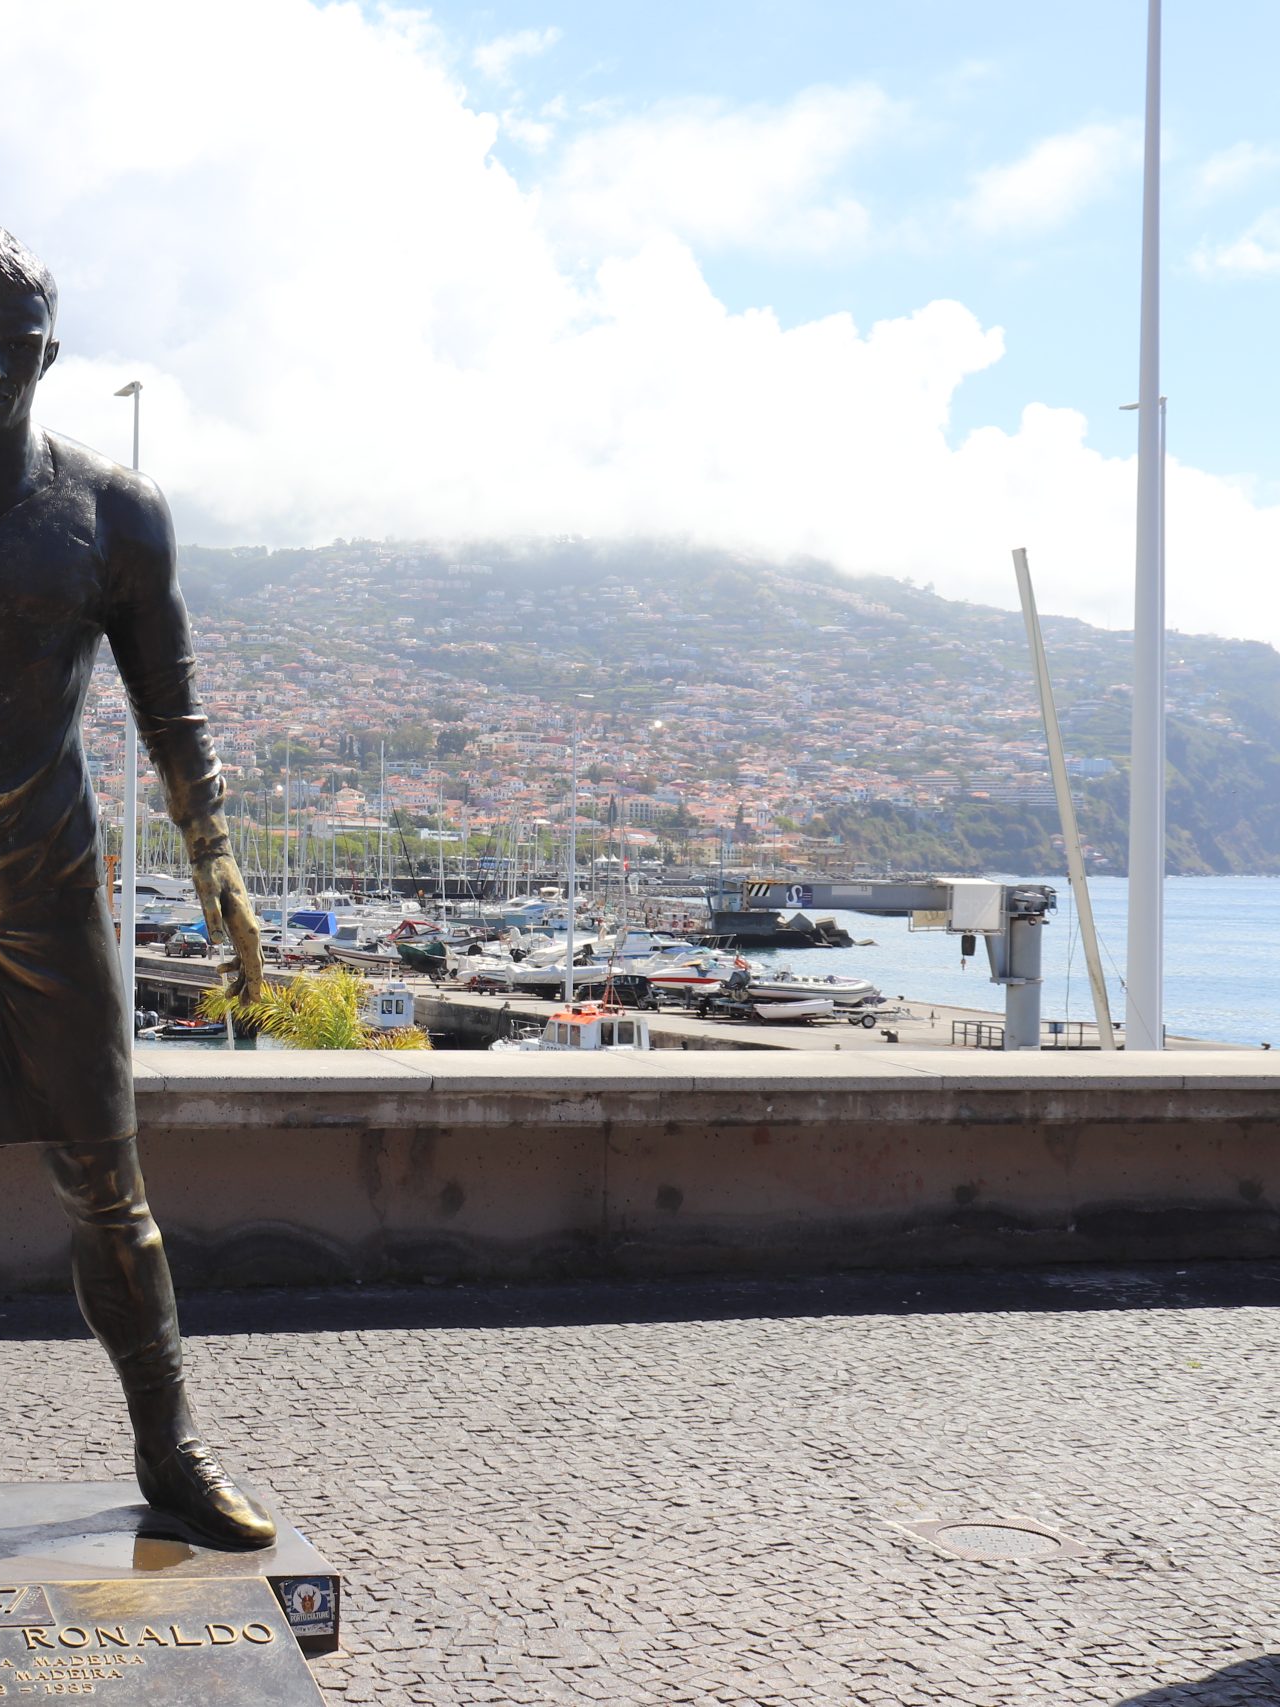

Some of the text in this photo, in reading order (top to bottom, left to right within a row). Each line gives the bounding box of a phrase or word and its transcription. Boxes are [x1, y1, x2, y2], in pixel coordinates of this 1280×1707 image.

[290, 1610, 330, 1622] PORTO CULTURE
[21, 1623, 275, 1650] RONALDO
[33, 1654, 145, 1668] MADEIRA
[15, 1668, 124, 1682] MADEIRA
[44, 1682, 95, 1694] 1985
